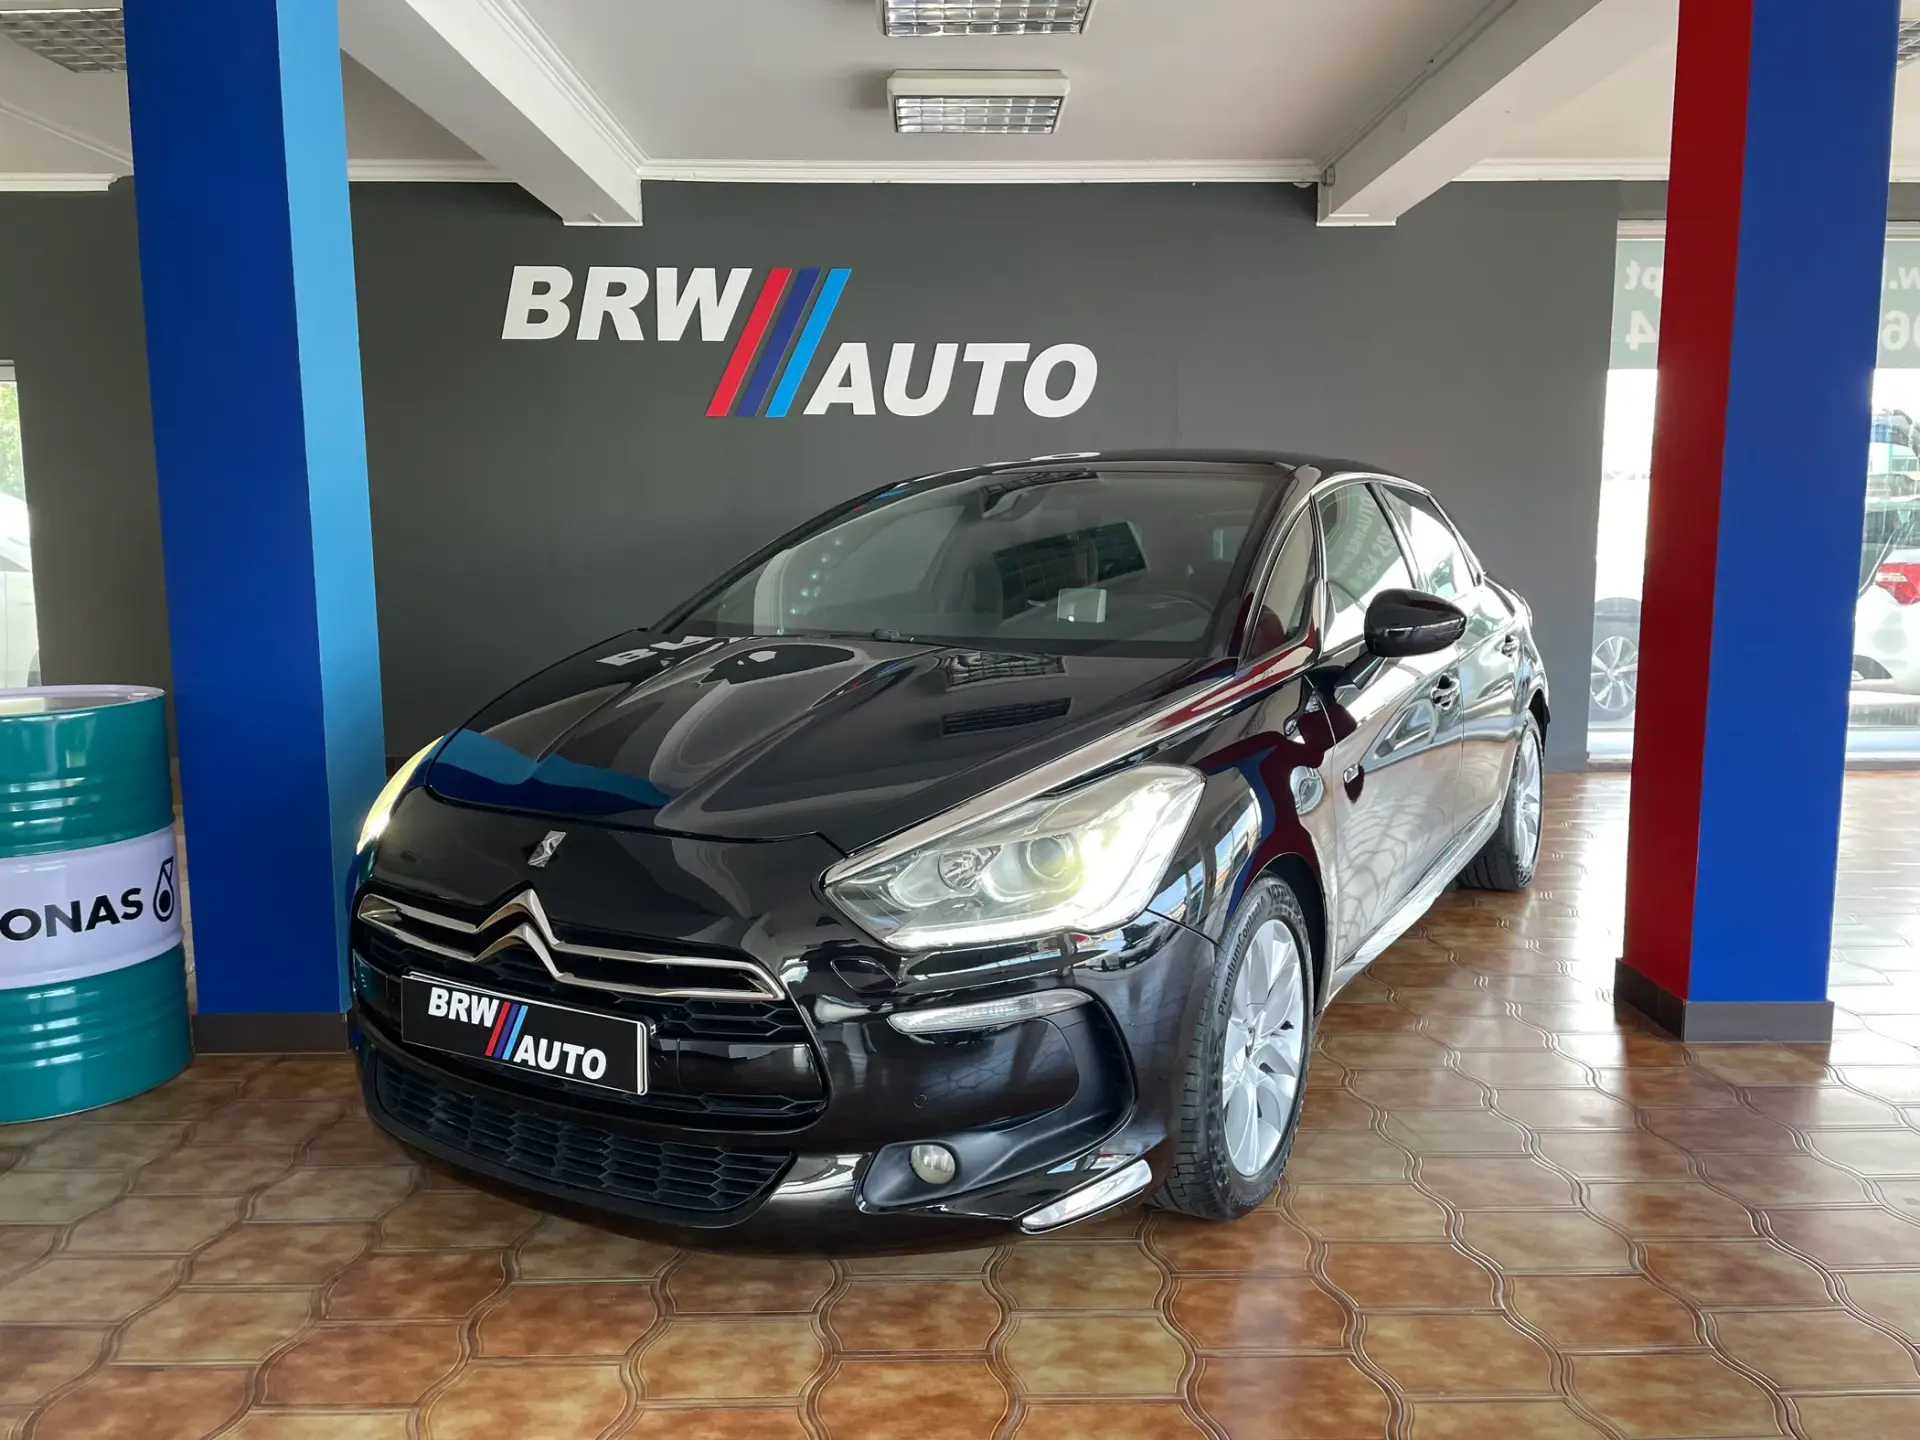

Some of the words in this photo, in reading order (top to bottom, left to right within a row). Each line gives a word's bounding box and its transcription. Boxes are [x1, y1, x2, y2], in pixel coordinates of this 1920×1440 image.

[501, 265, 752, 342] BRW
[802, 342, 1098, 418] AUTO
[427, 985, 499, 1029] BRW
[513, 1033, 608, 1081] AUTO
